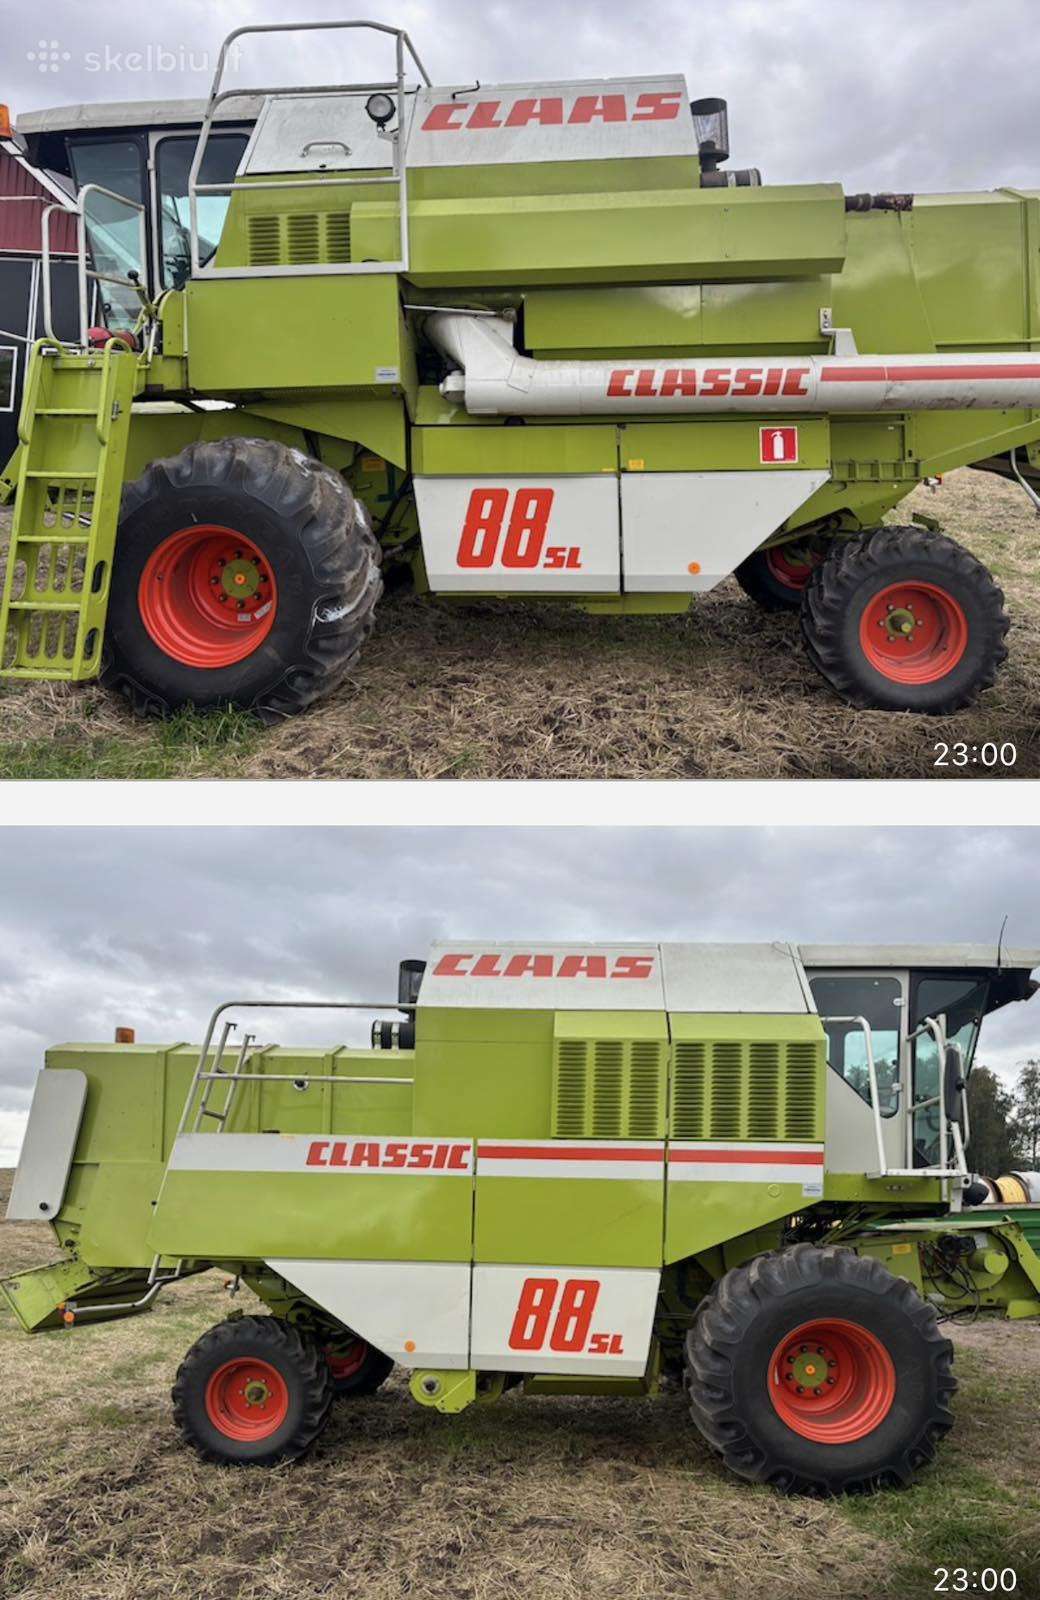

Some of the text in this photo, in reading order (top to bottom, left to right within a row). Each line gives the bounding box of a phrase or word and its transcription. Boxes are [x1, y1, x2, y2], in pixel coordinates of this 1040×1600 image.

[421, 92, 682, 131] CLAAS
[606, 368, 811, 397] CLASSIC
[432, 954, 654, 979] CLAAS
[306, 1141, 472, 1170] CLASSIC
